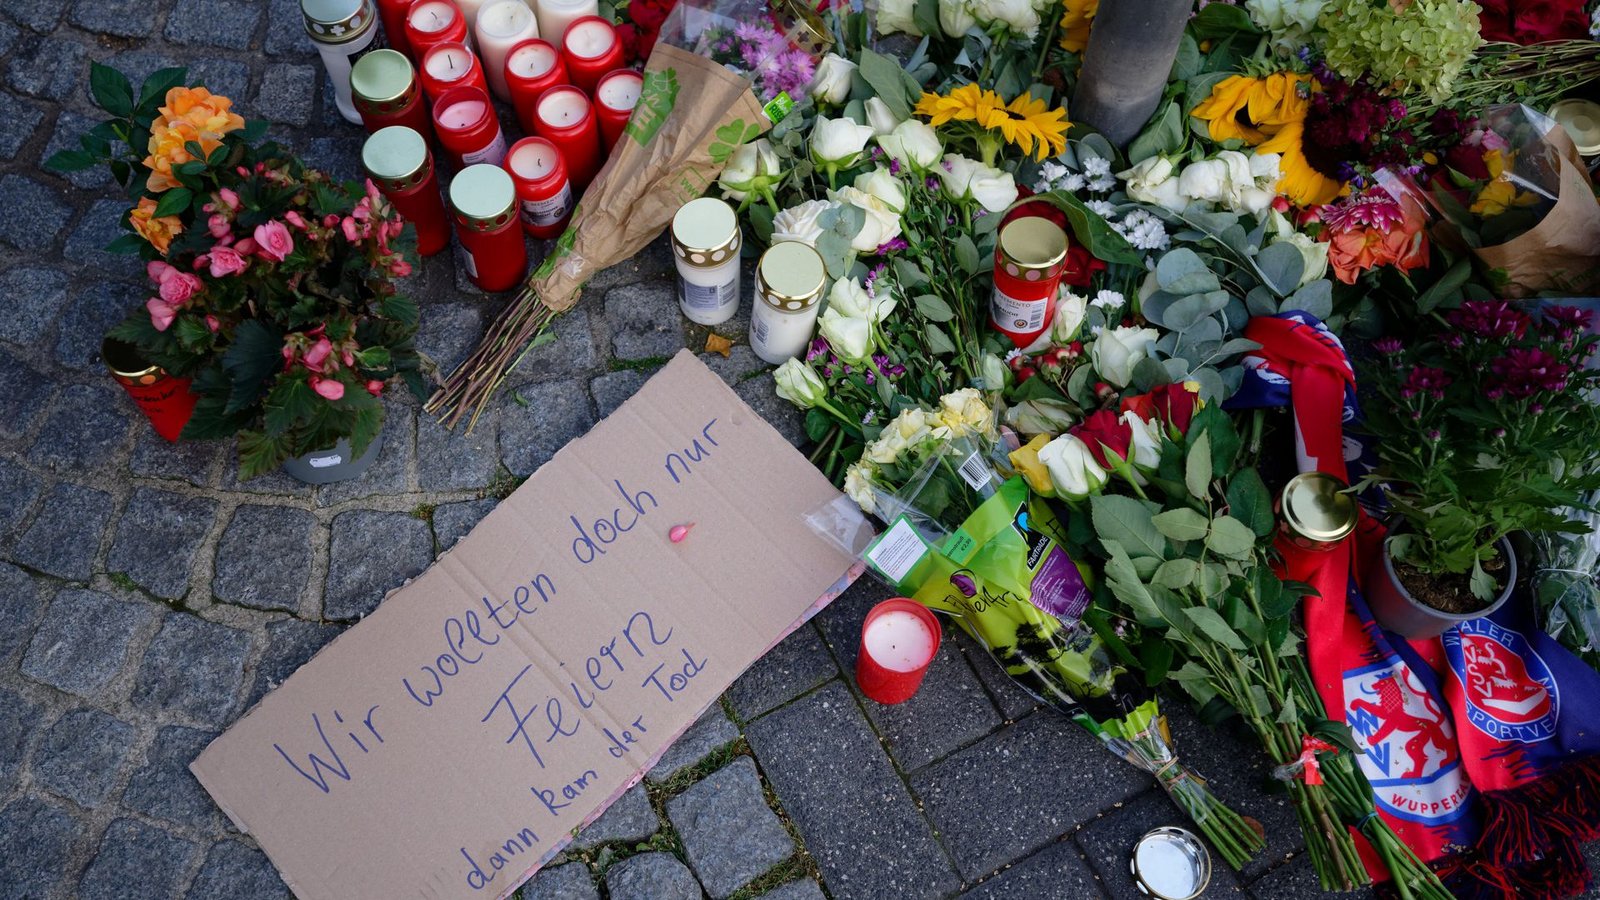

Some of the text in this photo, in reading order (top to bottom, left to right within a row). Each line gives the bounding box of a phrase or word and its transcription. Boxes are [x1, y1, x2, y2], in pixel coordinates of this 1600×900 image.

[273, 418, 718, 794] Wir wollten doch nur
[1028, 535, 1049, 567] FAIRTRADE
[460, 650, 708, 892] dann kam der Tod
[482, 610, 674, 769] Feiern
